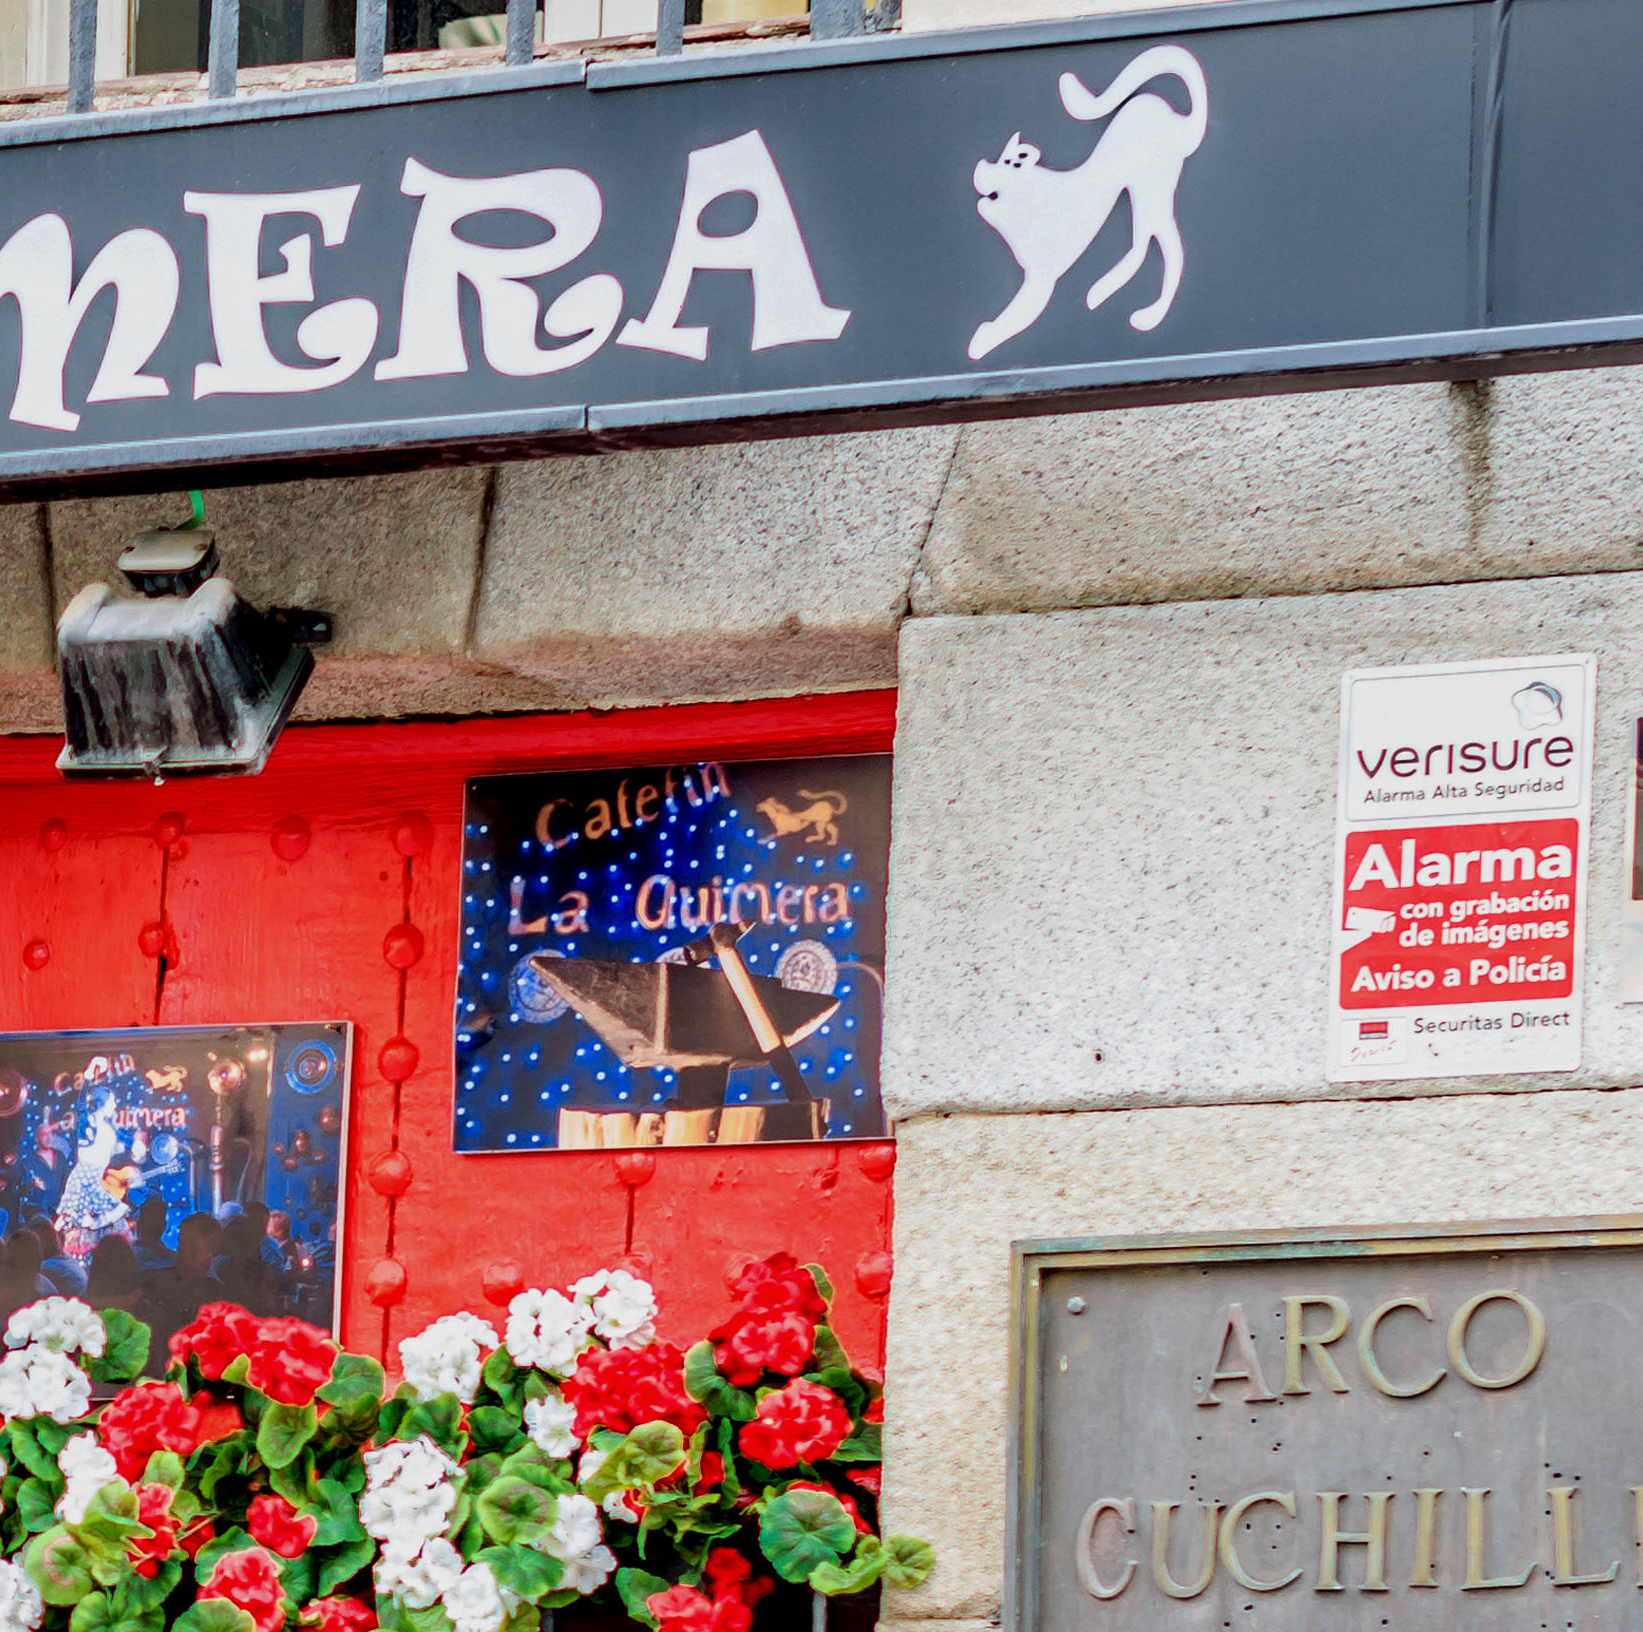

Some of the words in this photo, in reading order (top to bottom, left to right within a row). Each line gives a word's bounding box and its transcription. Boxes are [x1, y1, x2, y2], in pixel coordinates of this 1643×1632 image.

[1357, 736, 1574, 779] verisure
[1363, 788, 1425, 804] Alarma
[1432, 786, 1468, 800] Alta
[1474, 777, 1565, 800] Seguridad
[1348, 838, 1572, 891] Alarma
[508, 877, 590, 936] La
[635, 874, 850, 931] Quimera
[1400, 901, 1443, 920] con
[1450, 889, 1569, 922] grabación
[1399, 922, 1435, 947] de
[1441, 919, 1569, 949] imágenes
[1351, 964, 1435, 992] Aviso
[1442, 968, 1461, 988] a
[1469, 955, 1566, 986] Policía
[1414, 1016, 1502, 1034] Securitas
[1511, 1012, 1570, 1029] Direct
[115, 1105, 187, 1129] uimera
[1197, 1290, 1547, 1407] ARCO
[1076, 1486, 1643, 1600] CUCHILL
